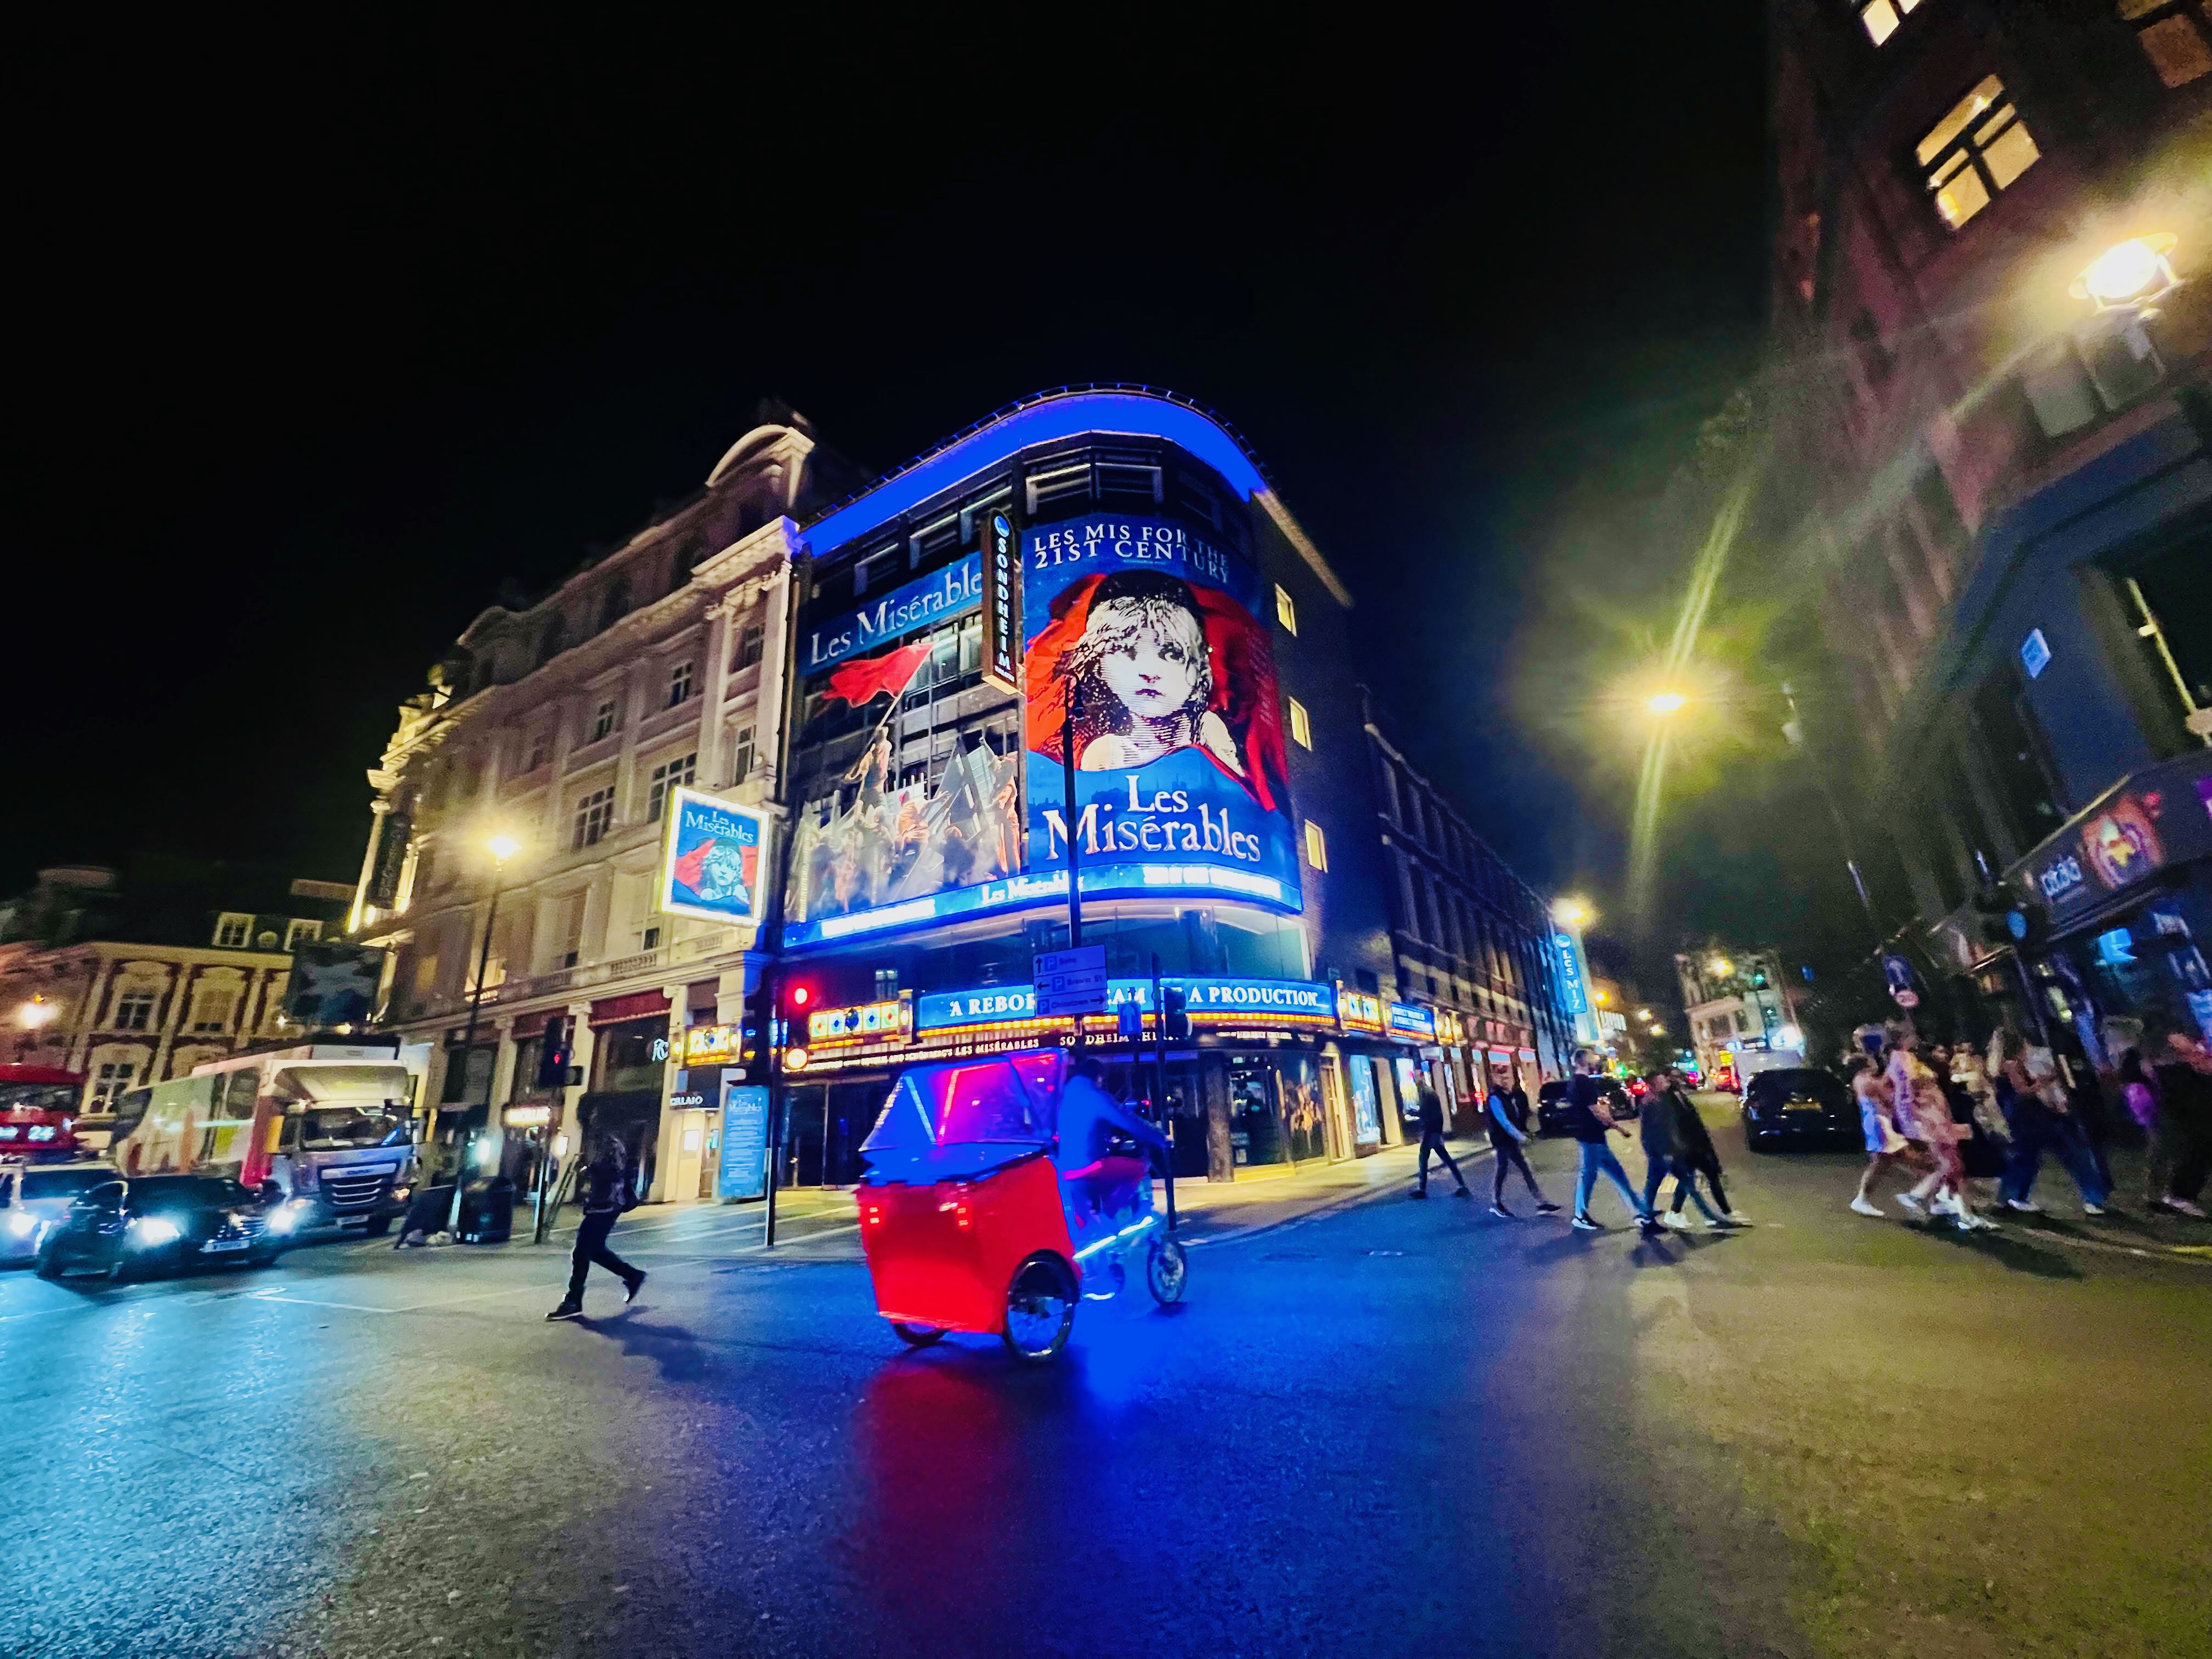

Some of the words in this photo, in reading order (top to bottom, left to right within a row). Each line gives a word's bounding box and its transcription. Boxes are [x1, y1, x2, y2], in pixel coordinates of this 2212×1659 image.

[1035, 529, 1074, 552] LES
[1086, 523, 1130, 541] MIS
[1142, 527, 1187, 545] FOR
[1194, 538, 1227, 566] THE
[1035, 539, 1101, 569] 21ST
[1115, 540, 1229, 584] CENTURY
[811, 629, 851, 664] Les
[857, 562, 983, 645] Misérable
[997, 537, 1011, 670] SONDHEIM
[1125, 775, 1189, 813] Les
[1042, 803, 1261, 861] Misérables
[1562, 950, 1575, 976] LES
[1188, 985, 1204, 1003] A
[1566, 979, 1581, 1009] MIZ
[955, 1045, 973, 1057] LES
[1059, 1033, 1130, 1047] SODHEIM
